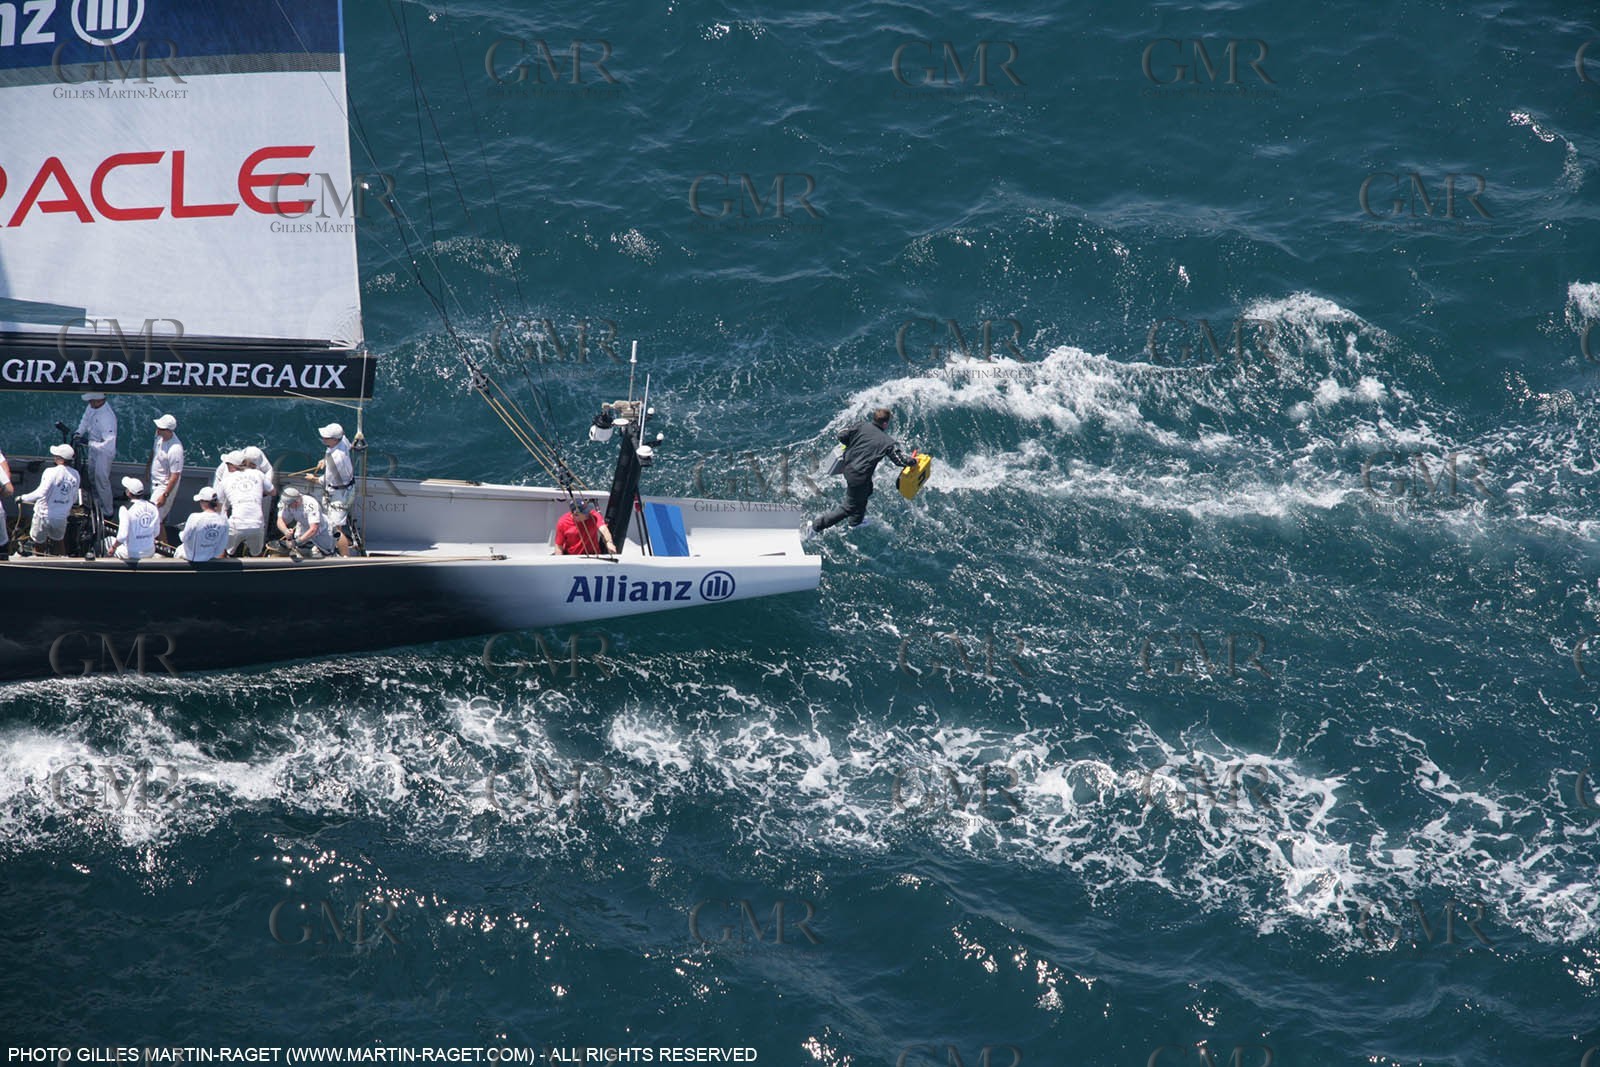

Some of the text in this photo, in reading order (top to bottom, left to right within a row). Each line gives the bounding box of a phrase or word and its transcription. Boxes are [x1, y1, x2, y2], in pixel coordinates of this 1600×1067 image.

[0, 145, 315, 228] ACLE
[1, 358, 348, 389] GIRARD-PERREGAUX
[566, 575, 693, 603] Allianz
